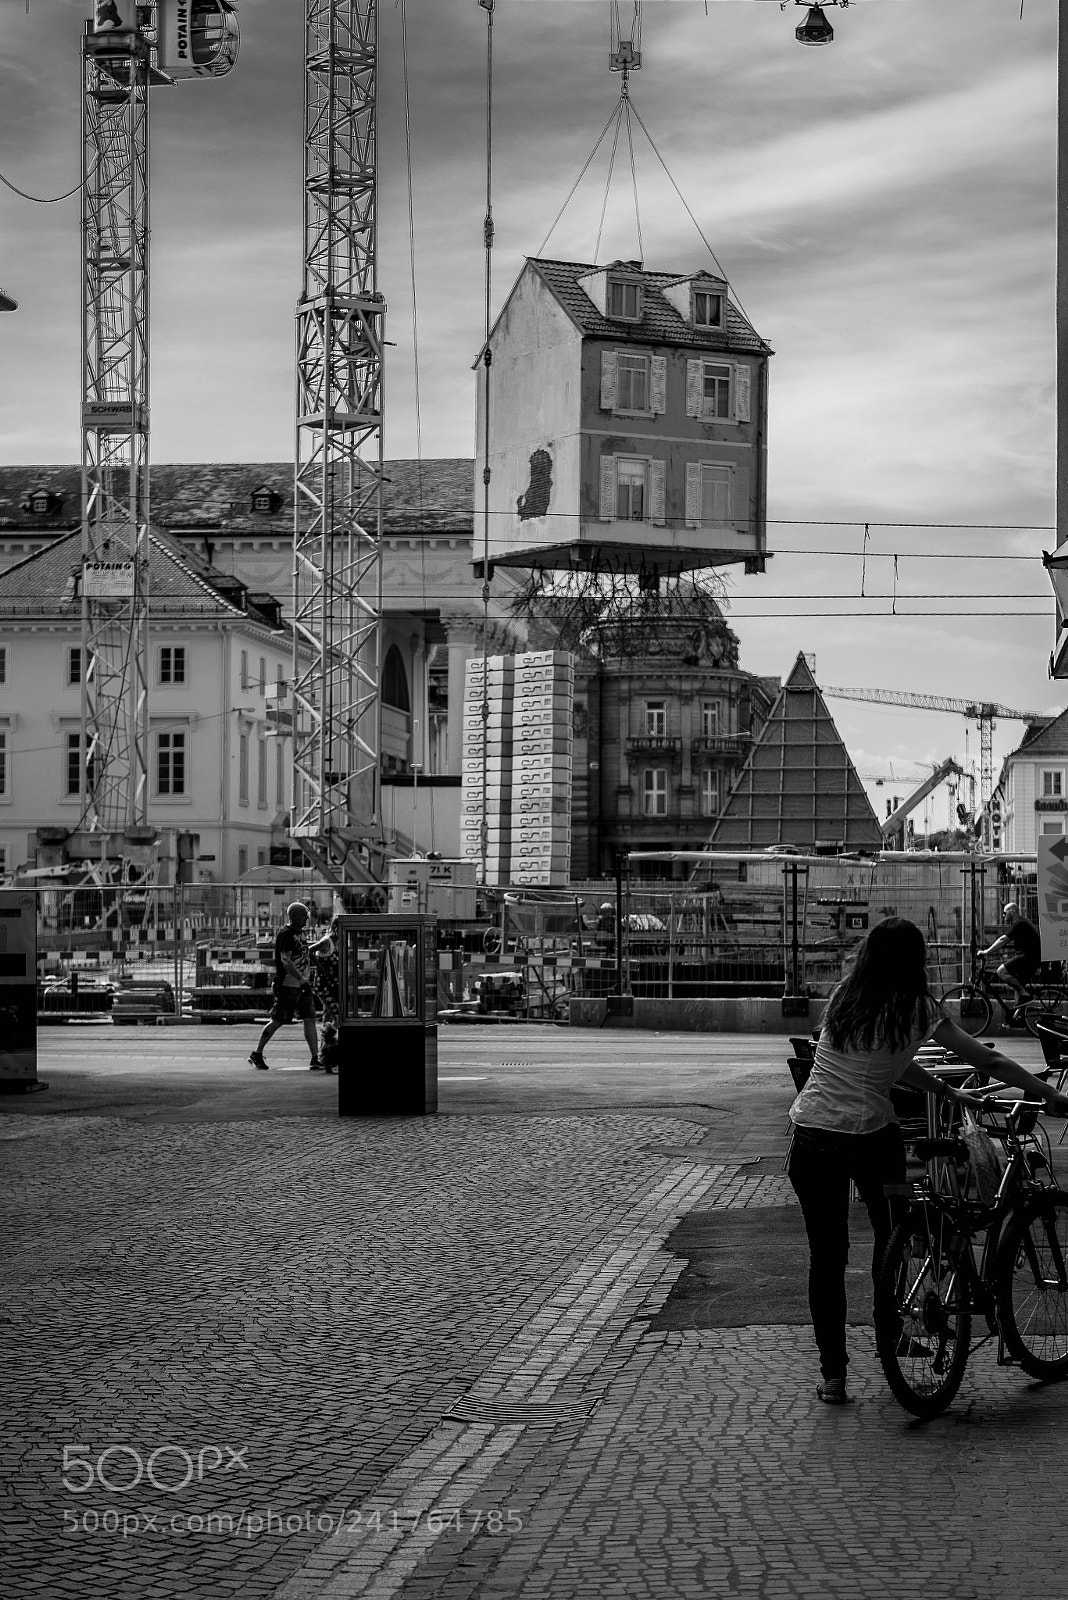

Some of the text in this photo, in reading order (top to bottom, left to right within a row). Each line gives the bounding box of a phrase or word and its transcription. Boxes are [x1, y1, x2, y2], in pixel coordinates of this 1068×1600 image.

[177, 8, 188, 59] POTAIN
[91, 405, 133, 414] SCHWAB
[86, 562, 123, 570] POTAIN
[429, 865, 440, 873] 71
